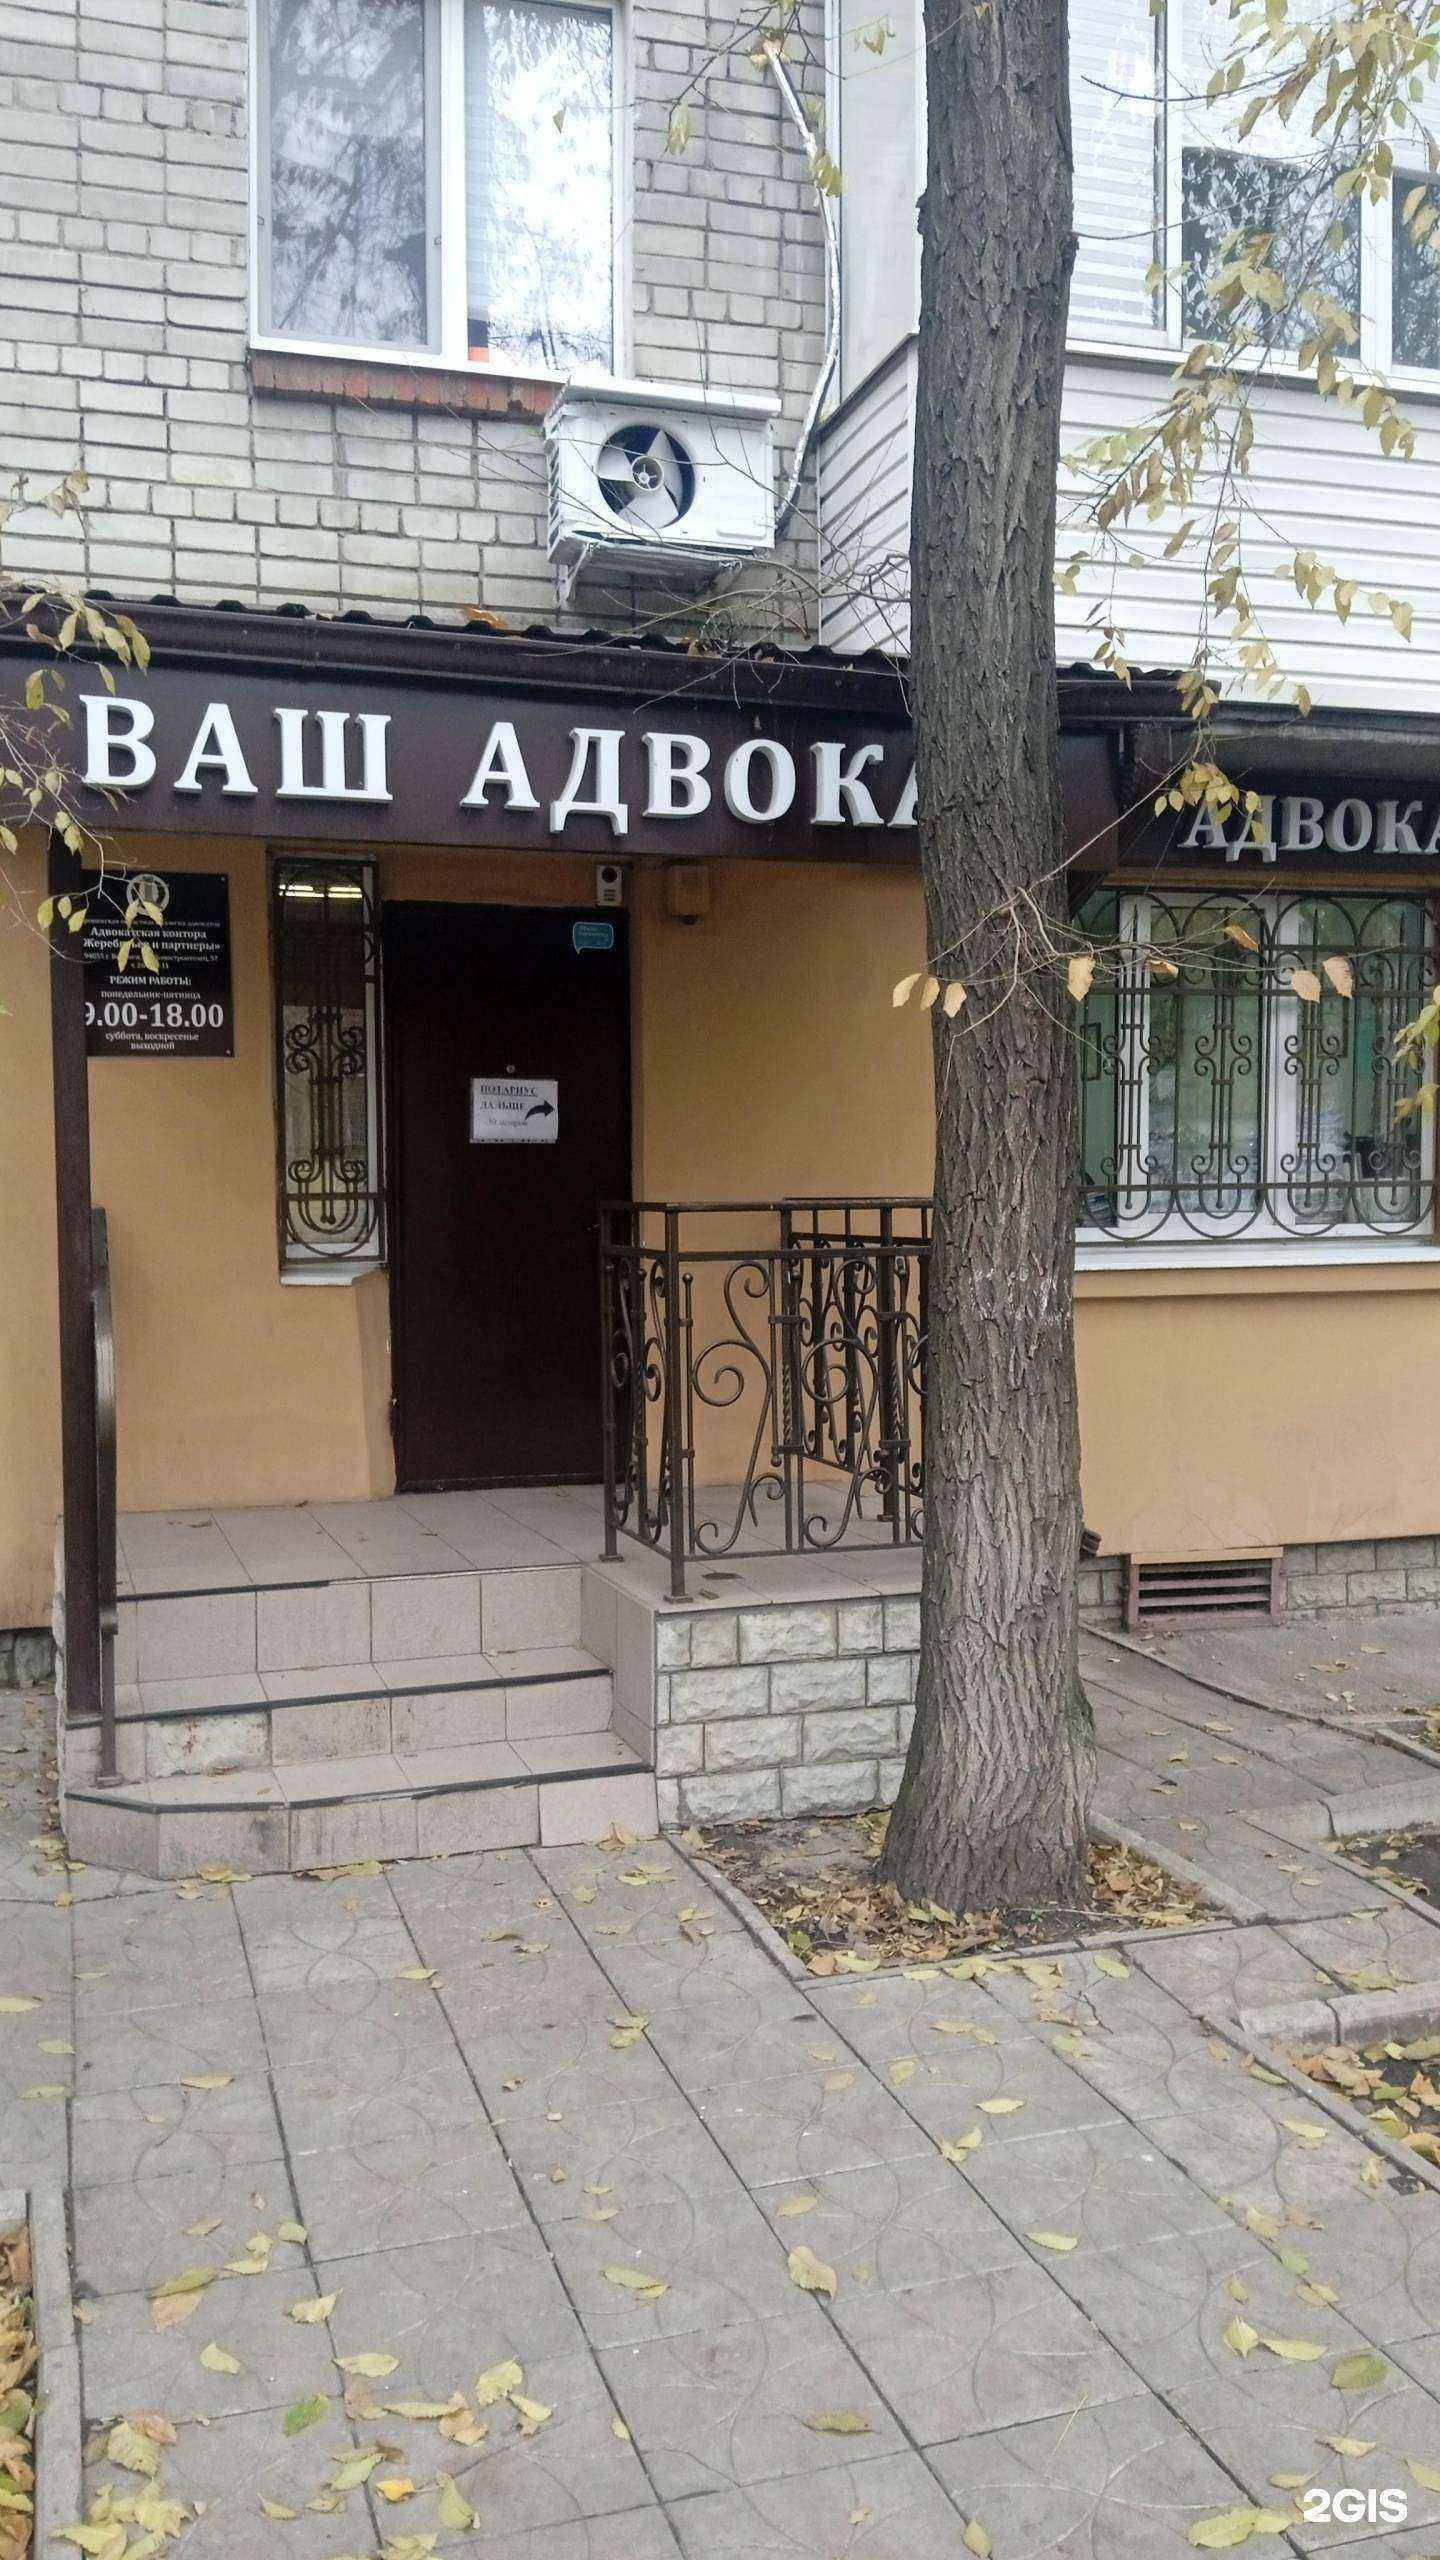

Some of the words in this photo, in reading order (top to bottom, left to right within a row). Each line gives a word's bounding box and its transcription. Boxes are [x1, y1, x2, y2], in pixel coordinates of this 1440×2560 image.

[79, 695, 393, 802] ВАШ
[1177, 796, 1440, 863] АДВОК
[90, 926, 160, 938] Адвокатская
[162, 930, 207, 940] контора
[109, 975, 147, 985] РЕЖИМ
[149, 976, 192, 986] РАБОТЫ:
[84, 1001, 224, 1028] 9.00-18.00
[105, 1031, 142, 1041] суббота,
[144, 1033, 199, 1042] воскресенье
[130, 1041, 175, 1050] выходной
